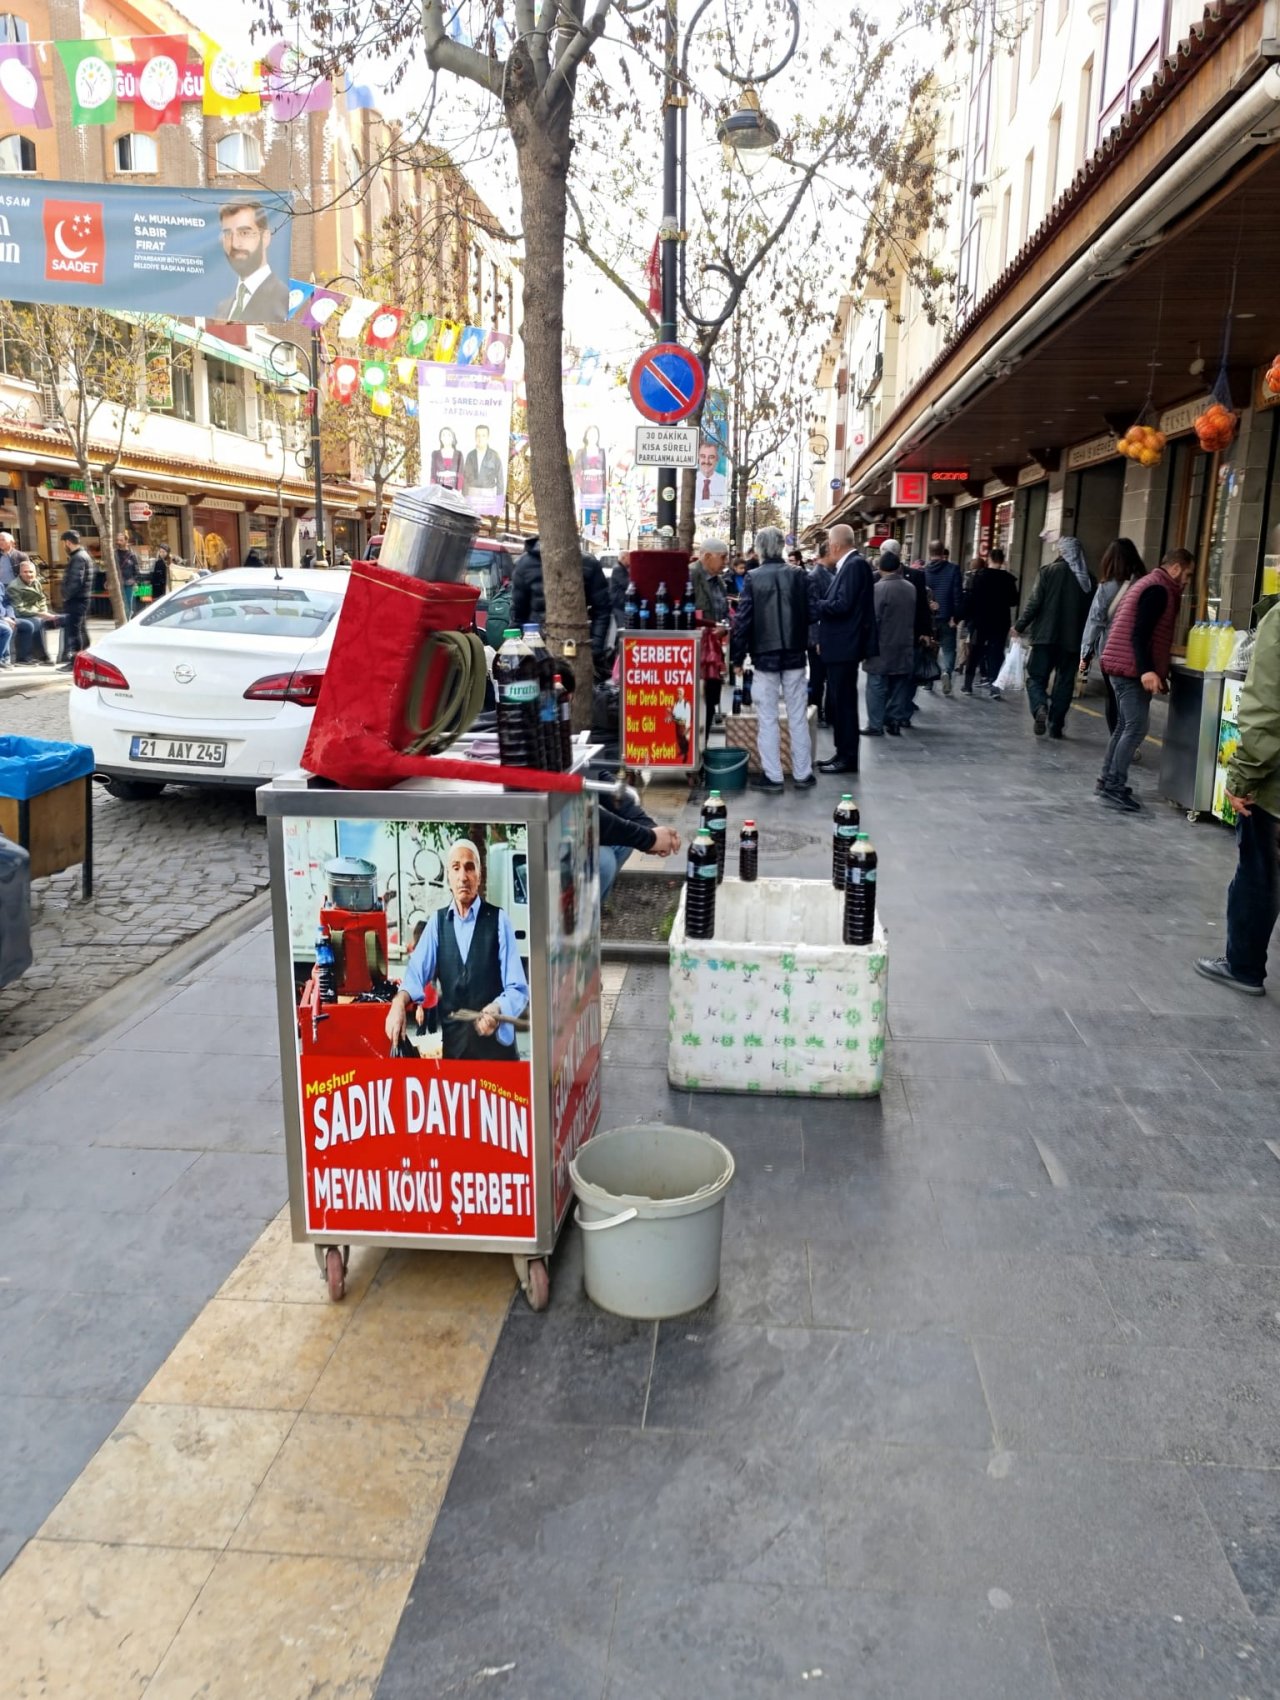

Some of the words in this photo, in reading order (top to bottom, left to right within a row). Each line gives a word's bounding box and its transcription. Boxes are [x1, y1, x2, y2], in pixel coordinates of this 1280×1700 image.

[134, 213, 148, 223] Av.
[149, 214, 206, 227] MUHAMMED
[136, 240, 166, 251] FIRAT
[51, 258, 99, 274] SAADET
[160, 263, 186, 273] BAŞKAN
[186, 266, 205, 274] ADAYI
[646, 432, 656, 440] 30
[657, 430, 688, 440] DAKİKA
[642, 443, 661, 452] KISA
[662, 442, 692, 452] SÜRELİ
[638, 453, 675, 463] PARKLANMA
[675, 455, 694, 463] ALANI
[931, 472, 969, 480] eczane
[903, 479, 921, 500] E
[664, 669, 693, 685] USTA
[626, 689, 638, 706] Her
[640, 689, 658, 707] Derde
[660, 690, 675, 707] Deva
[626, 716, 639, 733] Buz
[641, 715, 656, 733] Gibi
[140, 740, 156, 756] 21
[168, 742, 194, 759] AAY
[196, 744, 222, 761] 245
[651, 742, 677, 764] Şerbeti
[305, 1069, 356, 1099] Meşhur
[480, 1078, 512, 1099] 1970'den
[513, 1091, 529, 1105] beri
[313, 1078, 396, 1151] SADIK
[405, 1076, 529, 1158] DAYI'NIN
[313, 1166, 382, 1211] MEYAN
[388, 1157, 443, 1214] KÖKÜ
